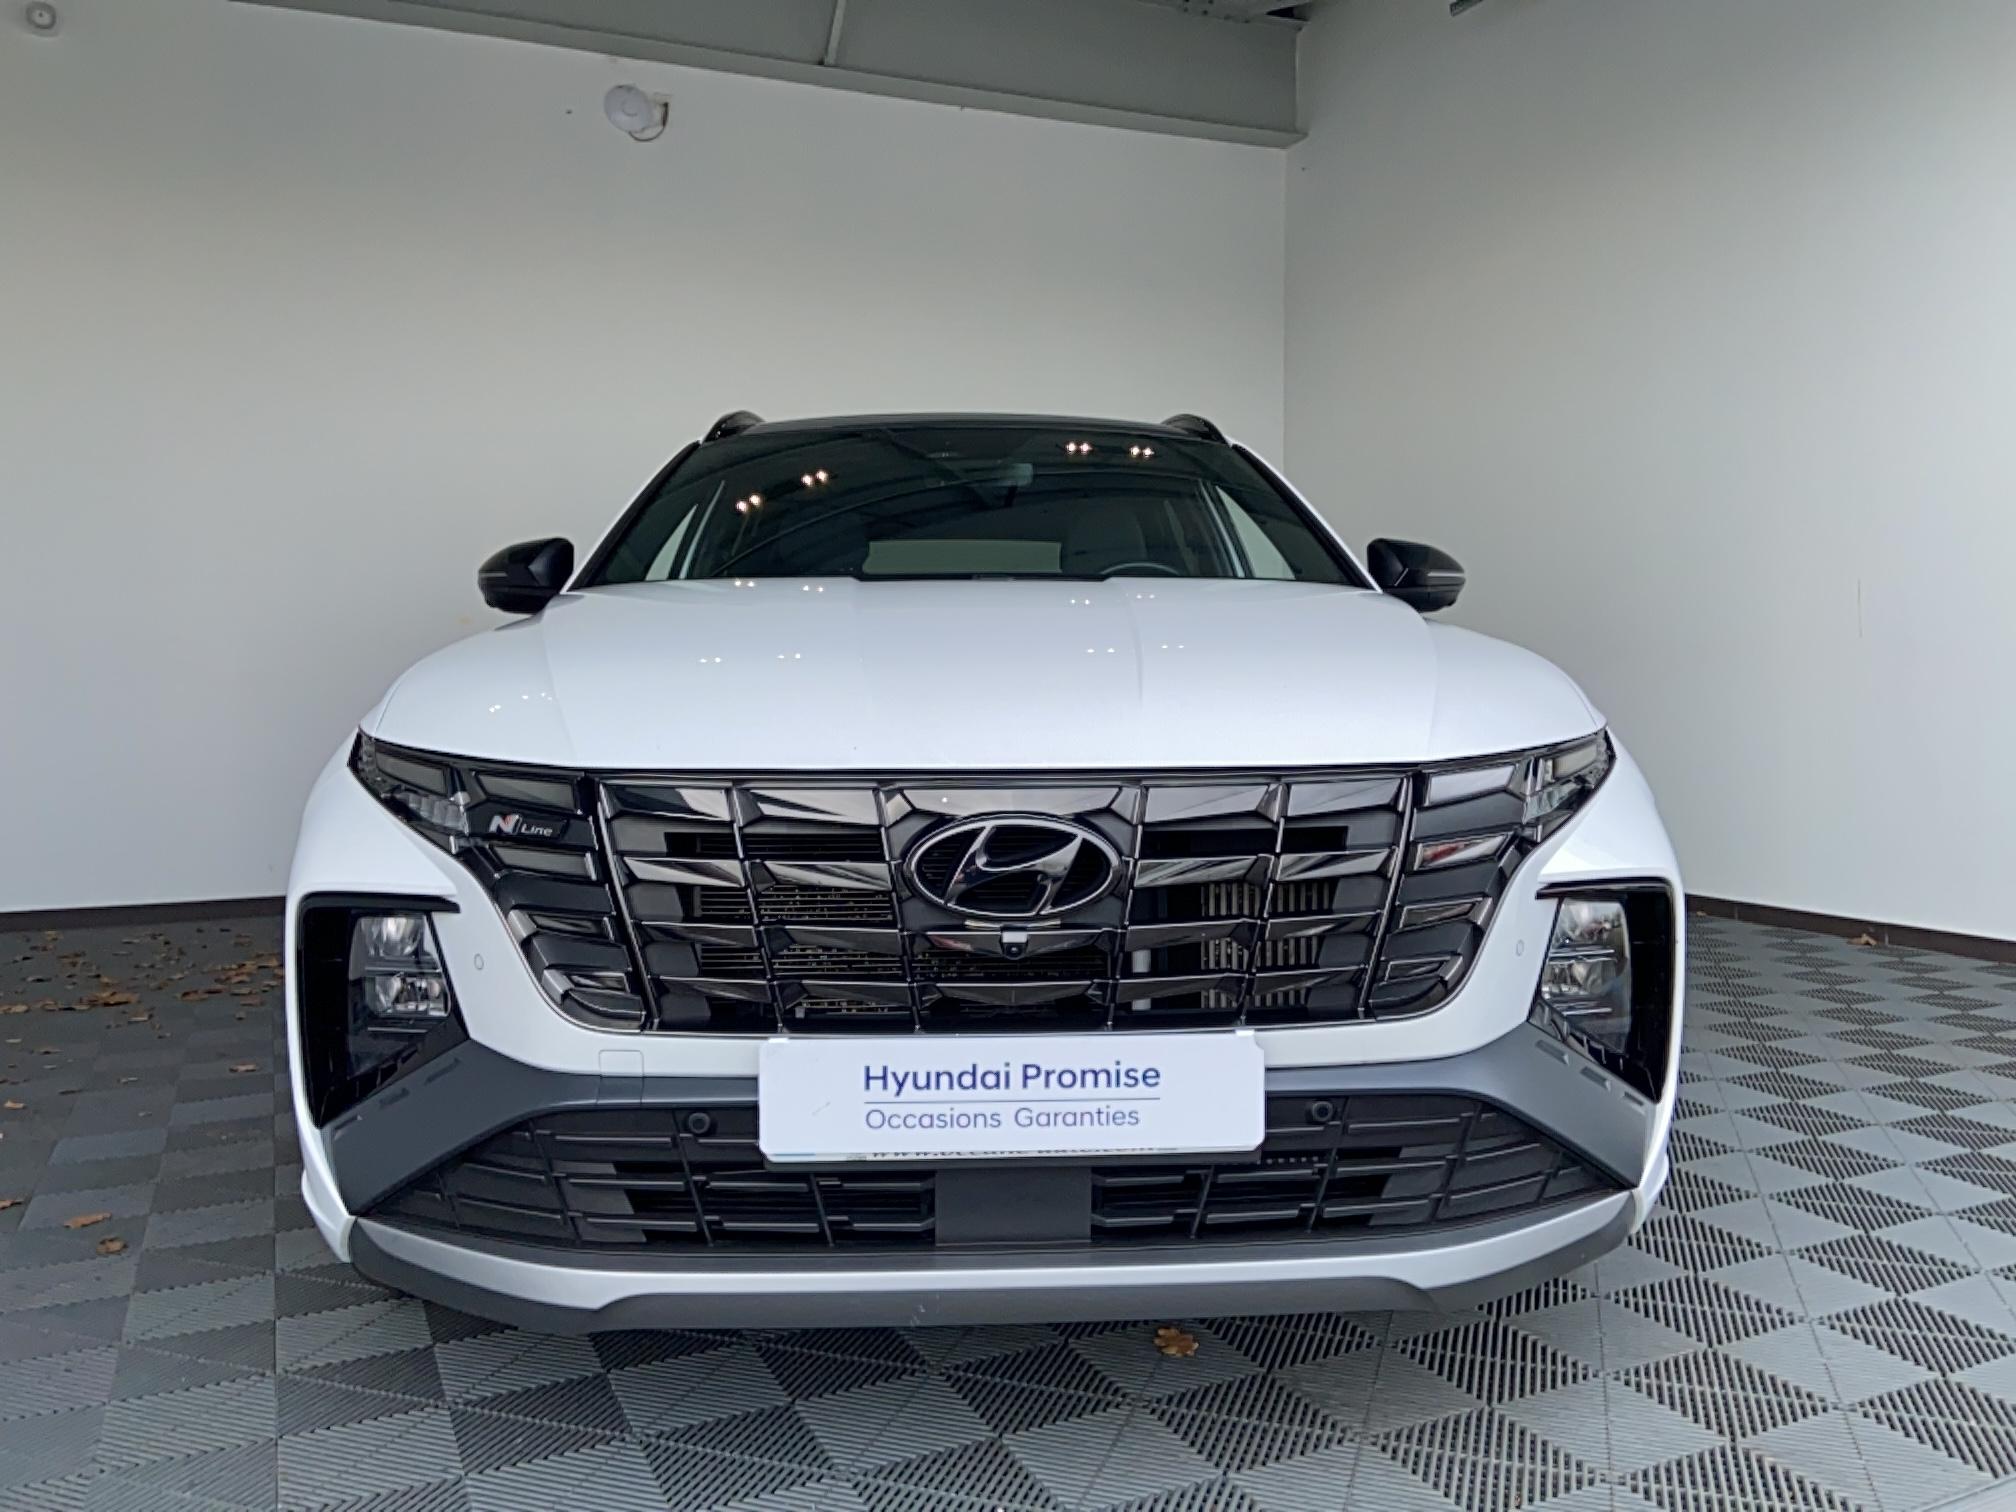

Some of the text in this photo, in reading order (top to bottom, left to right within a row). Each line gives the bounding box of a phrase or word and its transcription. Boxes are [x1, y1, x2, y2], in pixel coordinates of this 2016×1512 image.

[489, 814, 553, 837] N Line
[864, 1060, 1161, 1097] Hyundai Promise
[865, 1105, 1140, 1129] Occasions Garanties
